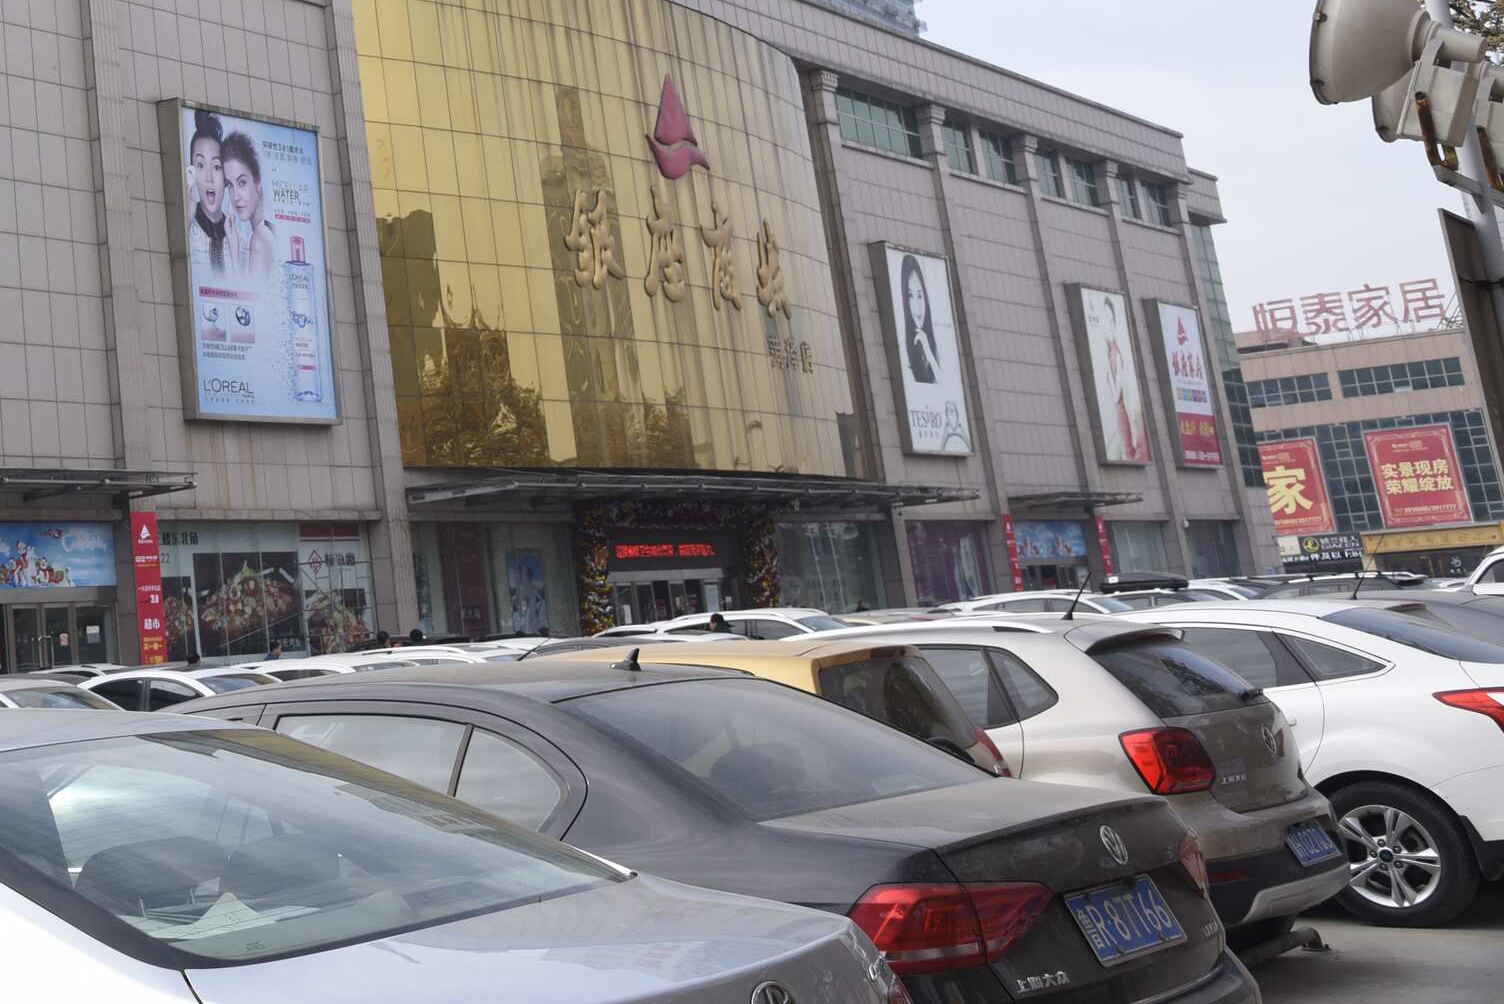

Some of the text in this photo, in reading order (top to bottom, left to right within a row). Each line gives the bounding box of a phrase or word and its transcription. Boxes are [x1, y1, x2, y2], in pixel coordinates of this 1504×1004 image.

[272, 187, 300, 201] WATER
[1251, 278, 1447, 341] 恒泰家居
[1380, 458, 1450, 479] 实景现房
[1263, 466, 1314, 515] 家
[1384, 475, 1455, 495] 荣耀绽放
[1016, 970, 1072, 994] 上海大众
